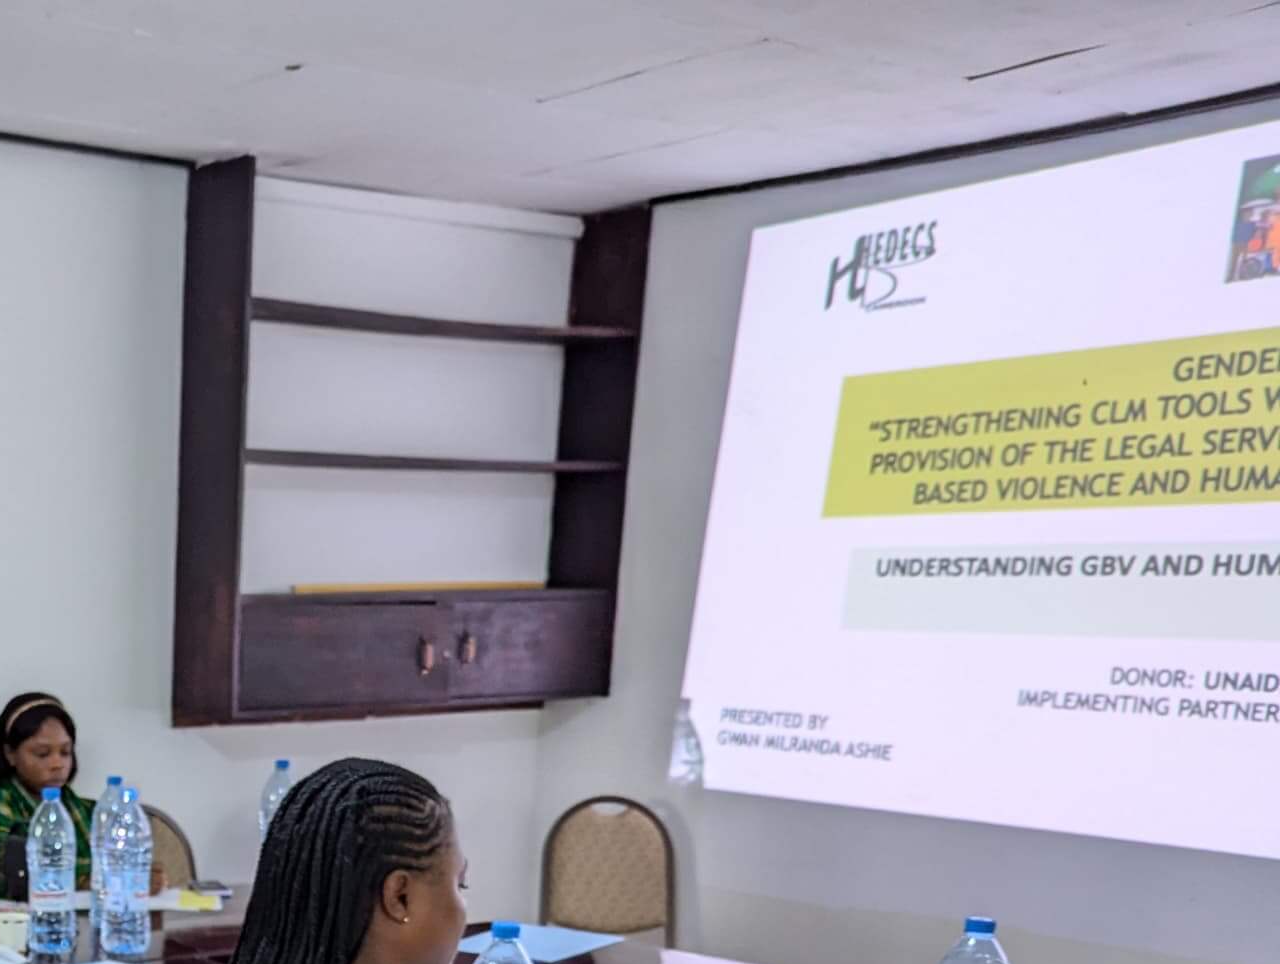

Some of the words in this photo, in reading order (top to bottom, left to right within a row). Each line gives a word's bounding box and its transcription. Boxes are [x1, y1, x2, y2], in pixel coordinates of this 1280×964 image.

[1173, 347, 1280, 382] GENDE
[1091, 398, 1147, 425] CLM
[1158, 388, 1252, 420] TOOLS
[869, 445, 995, 475] PROVISION
[1001, 442, 1037, 467] OF
[1044, 438, 1096, 465] THE
[1104, 432, 1192, 461] LEGAL
[1202, 426, 1280, 455] SERV
[912, 479, 988, 505] BASED
[996, 472, 1124, 501] VIOLENCE
[1129, 469, 1190, 495] AND
[876, 556, 1073, 577] UNDERSTANDING
[1080, 555, 1136, 577] GBV
[1141, 554, 1204, 577] AND
[1109, 666, 1195, 690] DONOR:
[1016, 689, 1170, 717] IMPLEMENTING
[720, 707, 802, 730] PRESENTED
[807, 714, 828, 731] BY
